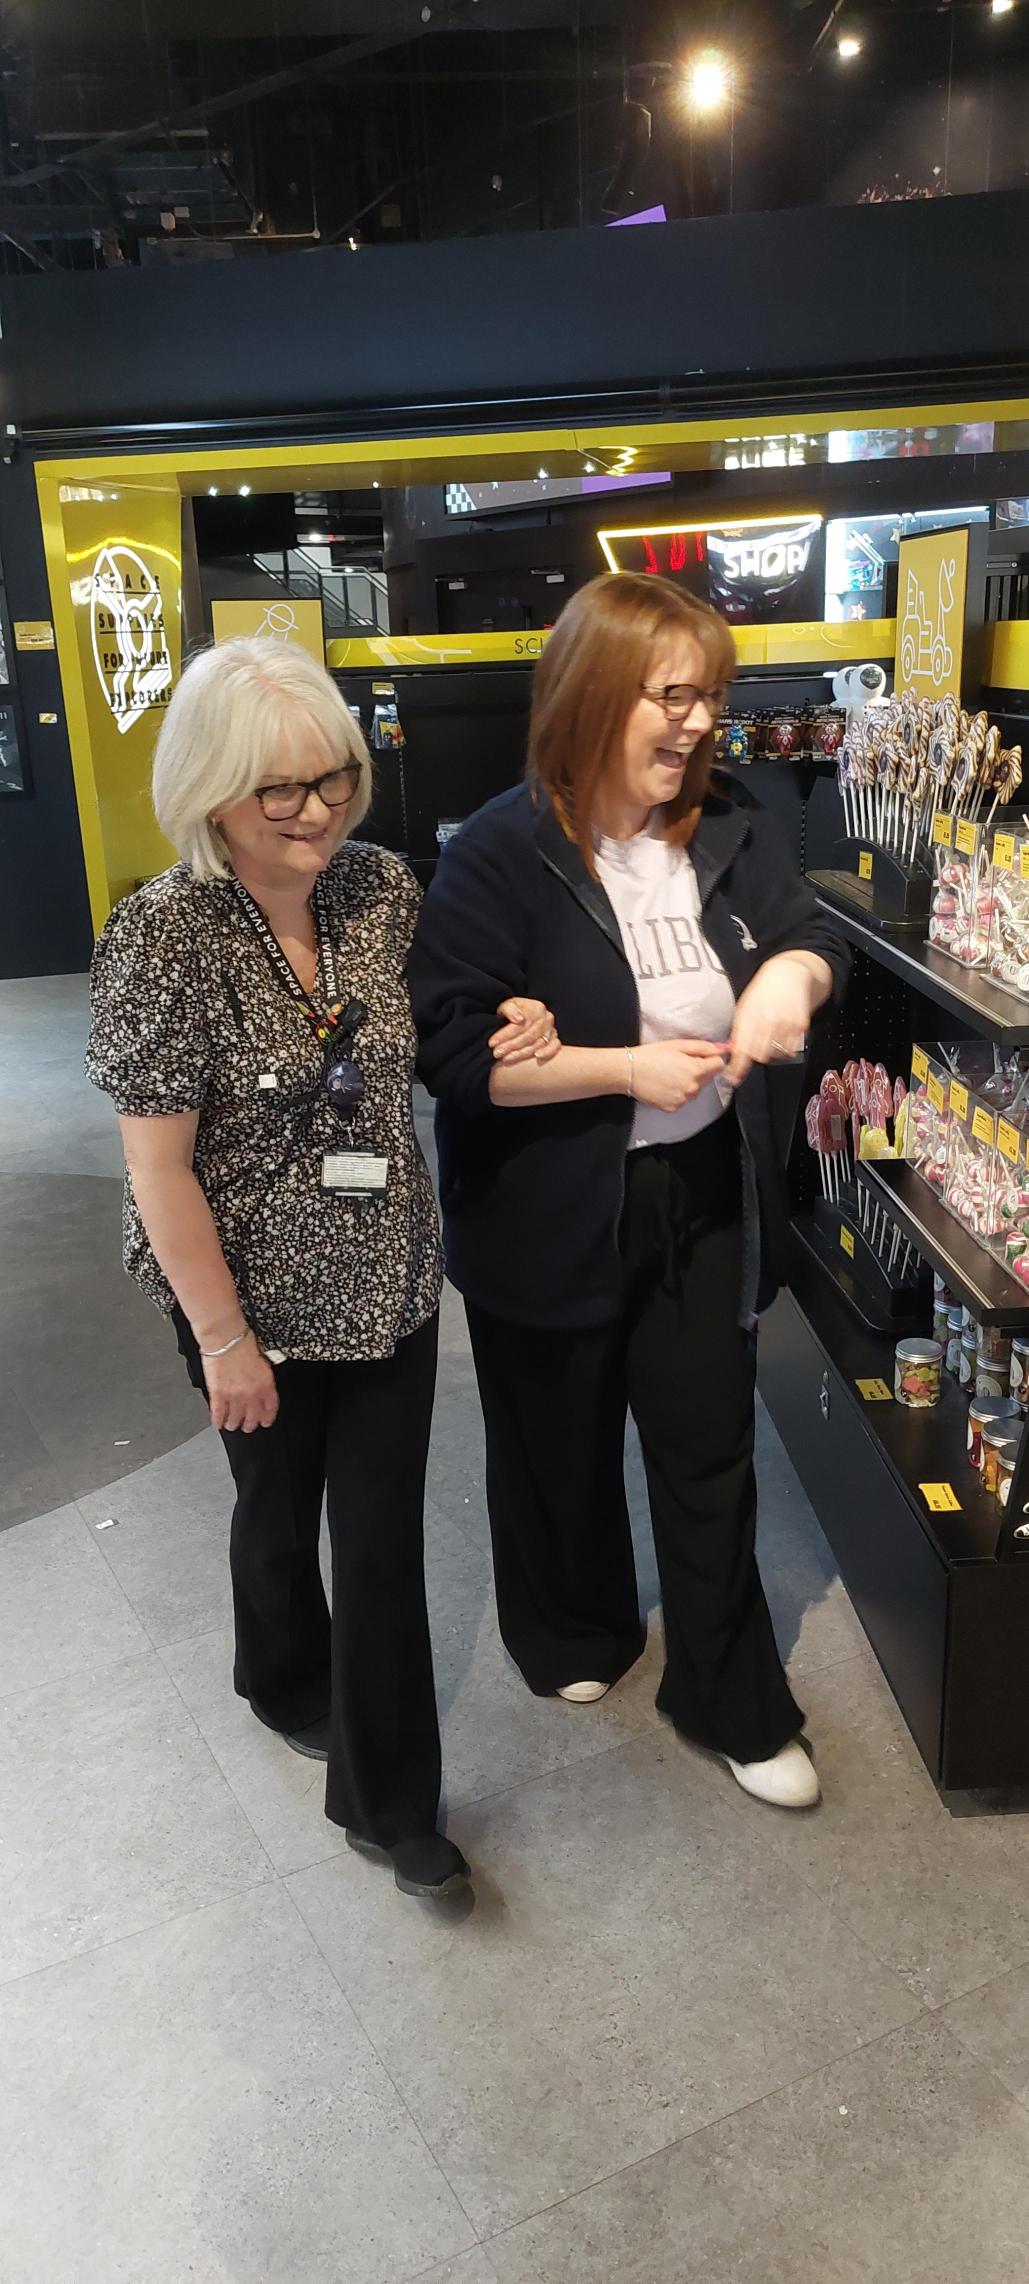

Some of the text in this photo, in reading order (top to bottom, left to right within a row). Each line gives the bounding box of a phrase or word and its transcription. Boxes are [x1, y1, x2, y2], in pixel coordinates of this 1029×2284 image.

[724, 544, 805, 579] SHOP
[229, 874, 303, 996] SPACE FOR EVERYONE
[315, 875, 337, 999] PACE FOR EVERYONE
